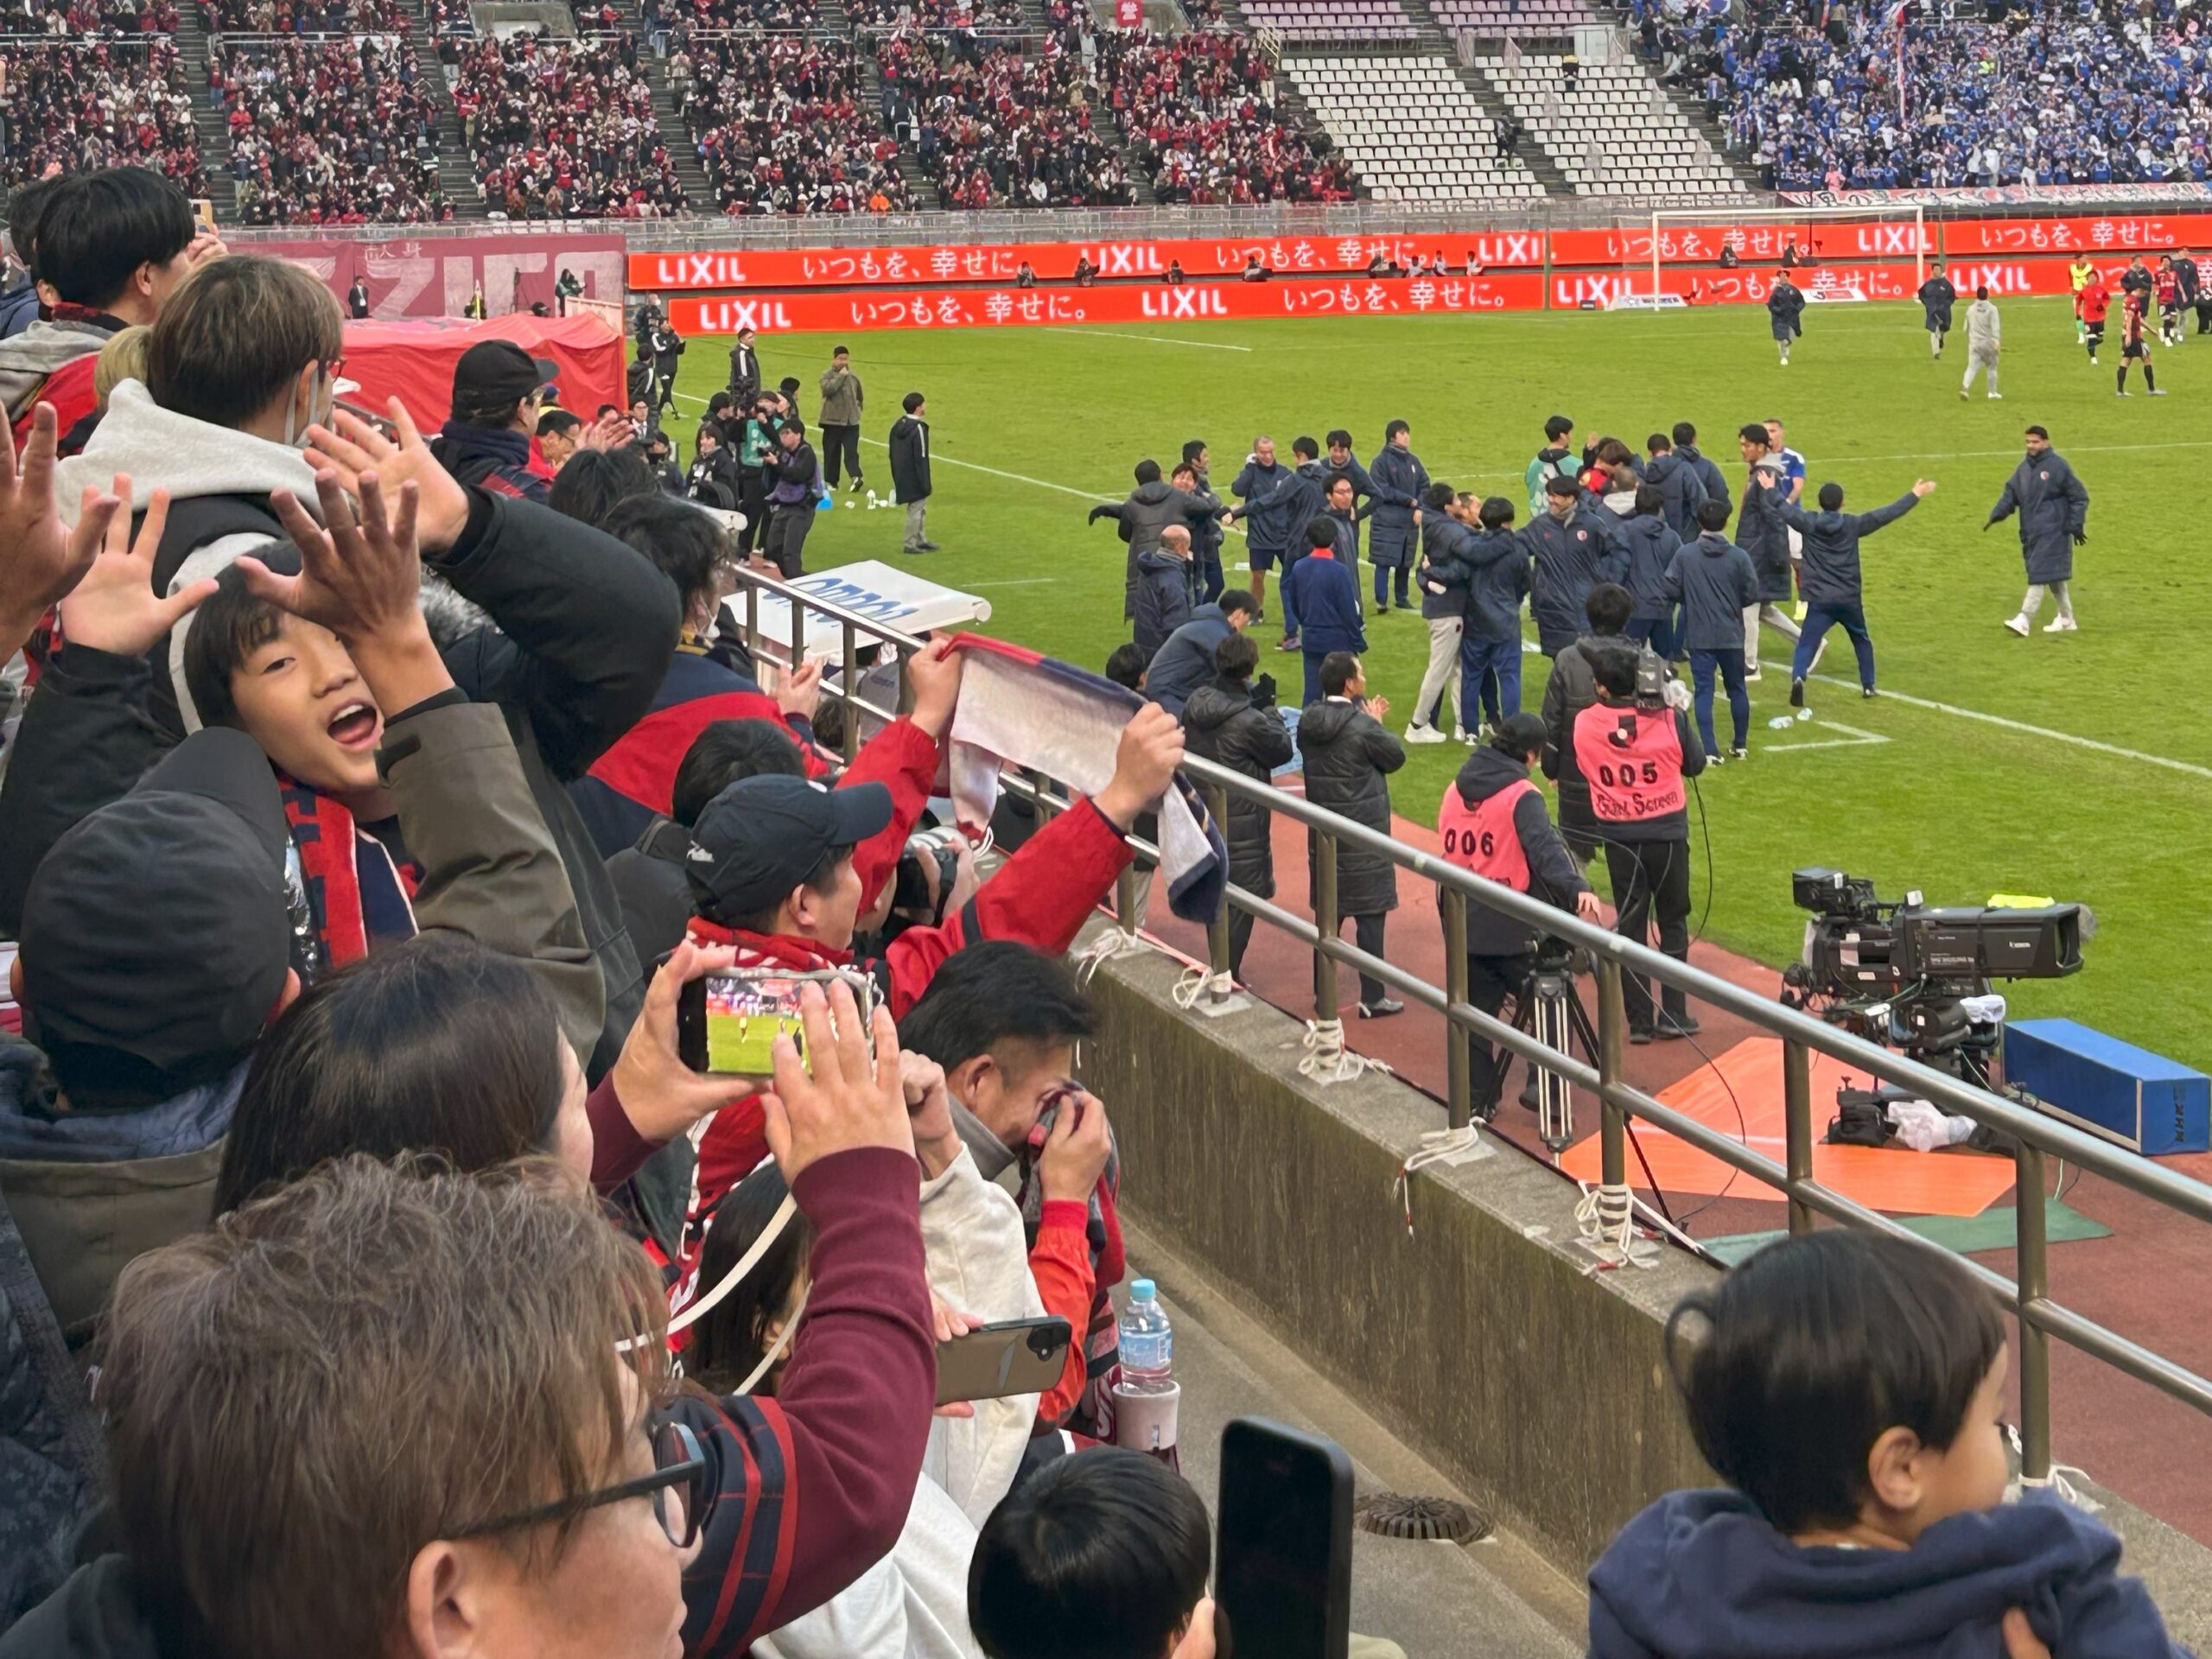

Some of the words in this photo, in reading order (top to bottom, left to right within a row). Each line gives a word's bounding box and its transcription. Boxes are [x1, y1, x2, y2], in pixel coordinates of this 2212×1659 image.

[1858, 225, 1933, 253] LIXIL
[1982, 219, 2174, 249] いつもを、幸せに。
[658, 254, 747, 285] LIXIL
[1953, 263, 2031, 295] LIXIL
[850, 291, 1085, 326] いつもを、幸せに。
[1141, 286, 1228, 319] LIXIL
[1283, 279, 1504, 312] いつもを、幸せに。
[700, 300, 791, 333] LIXIL
[1599, 761, 1658, 788] 005
[1444, 828, 1494, 856] 006
